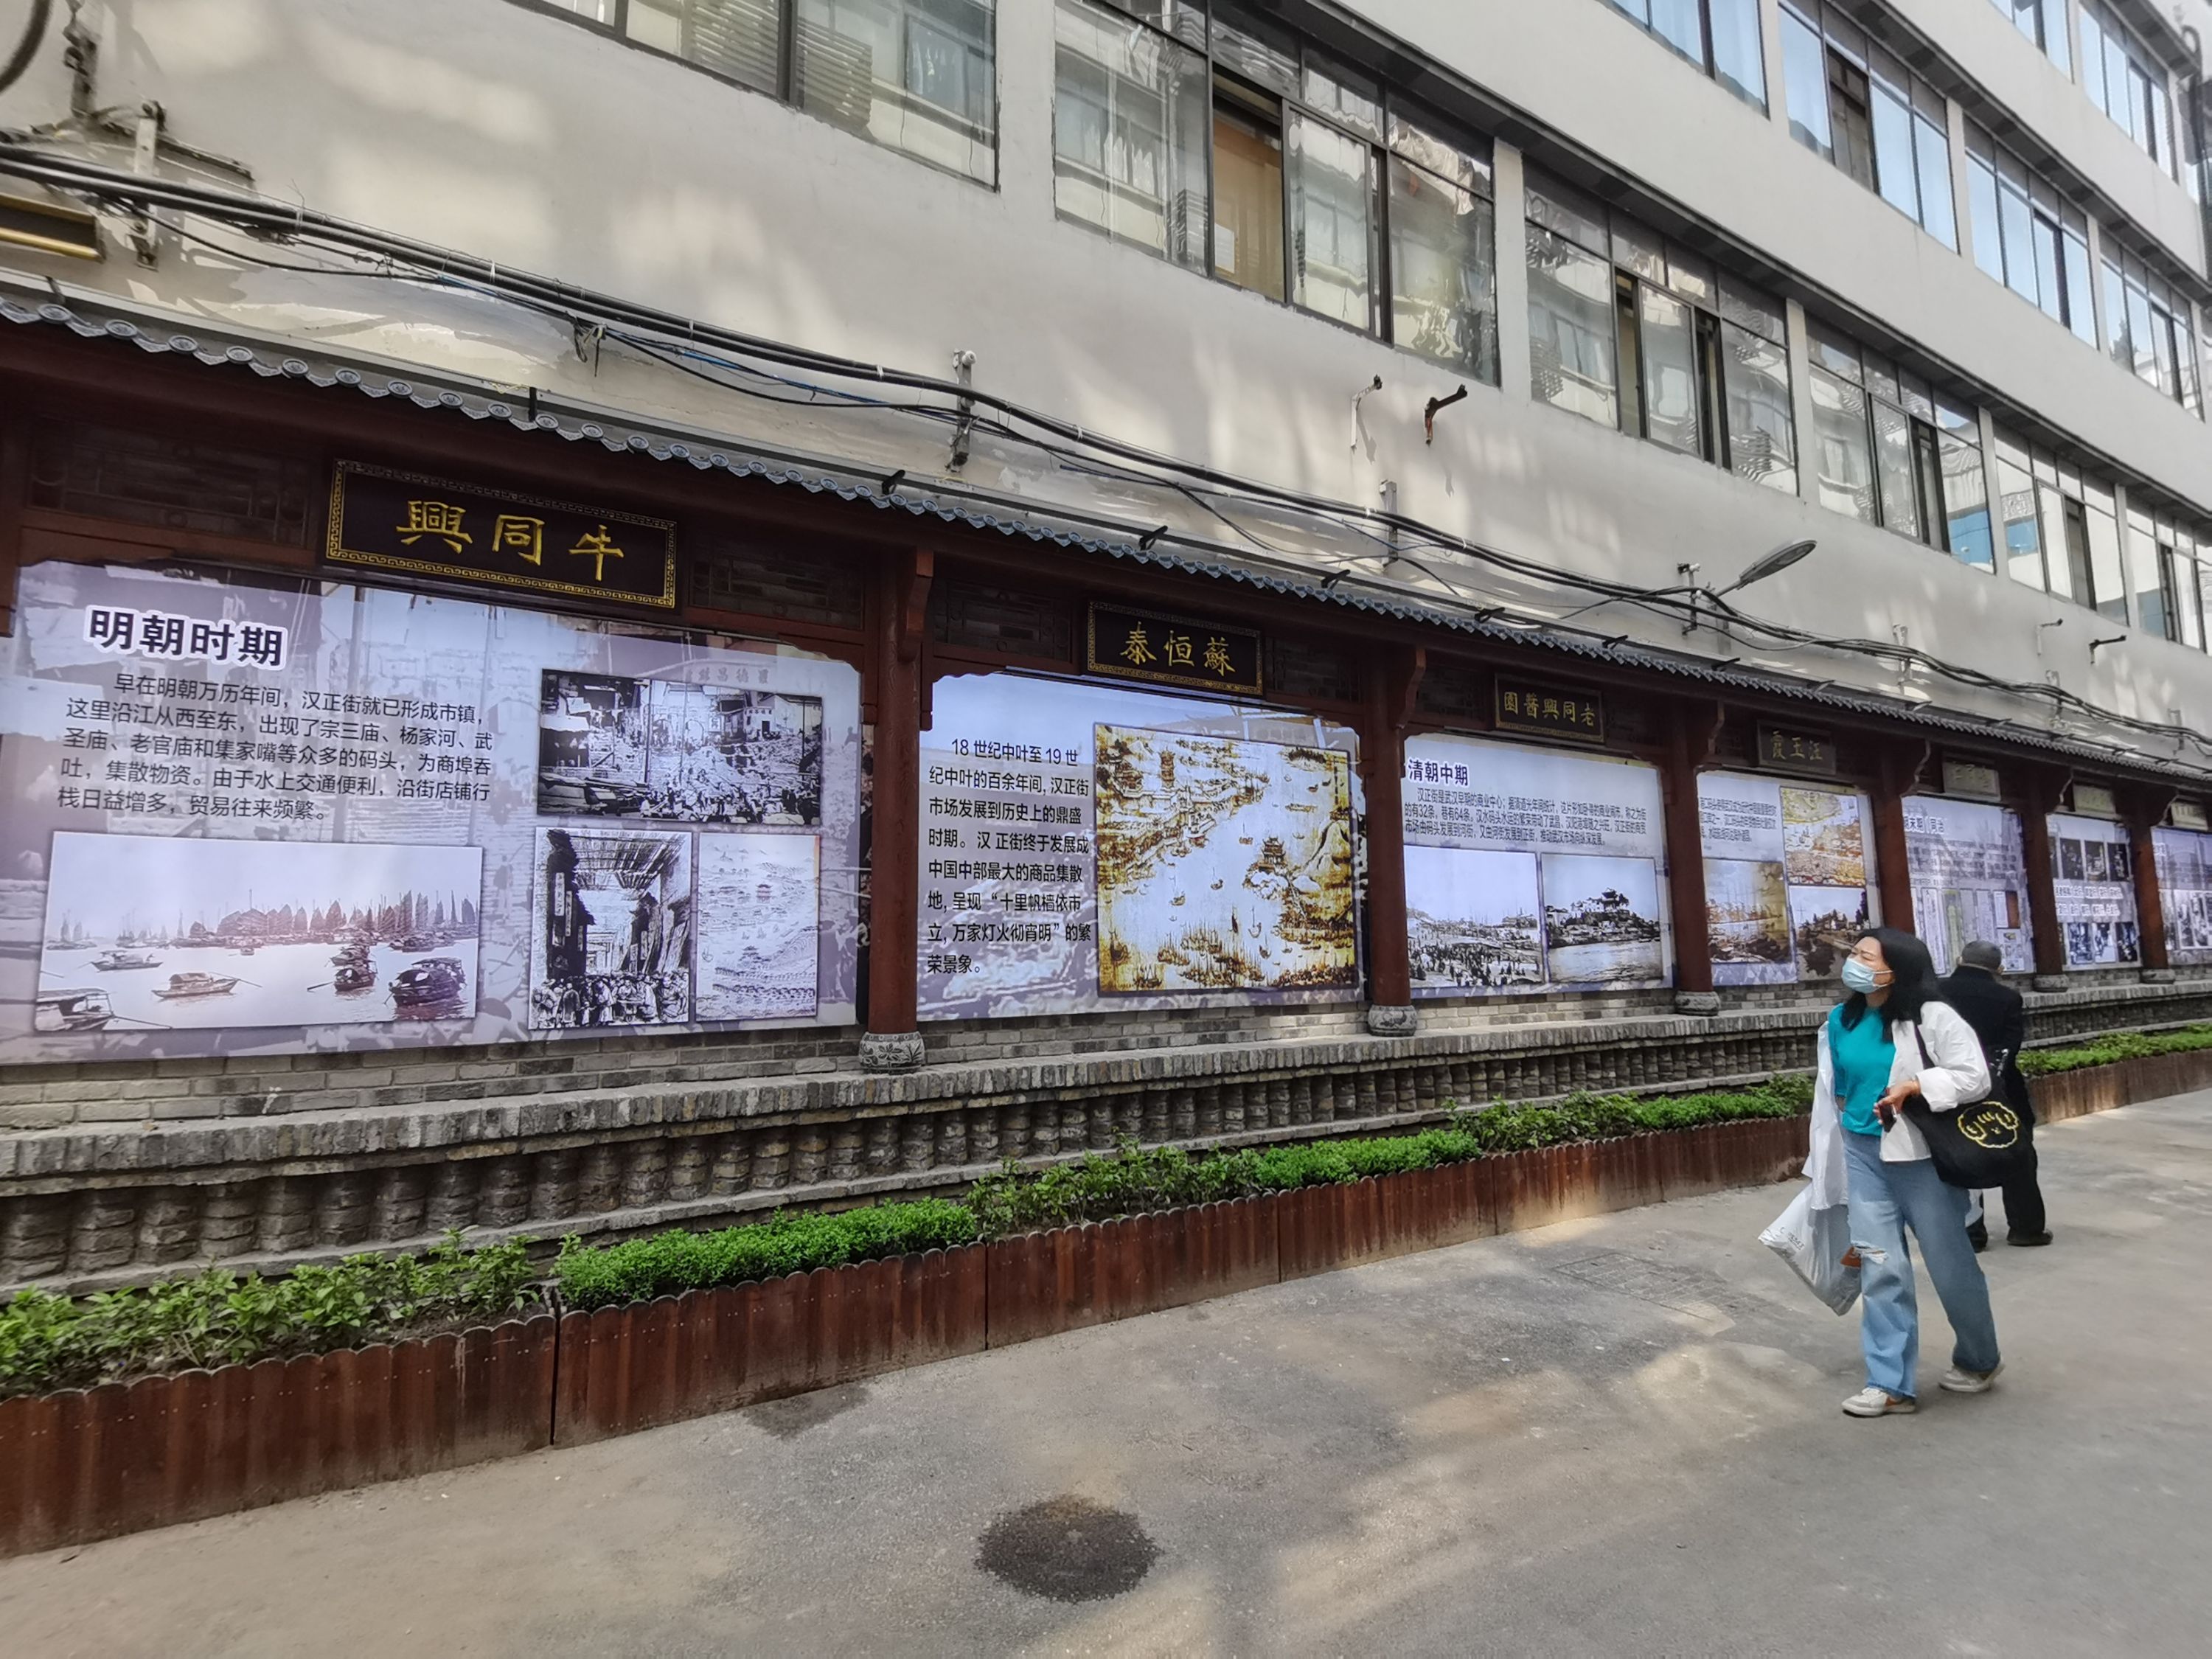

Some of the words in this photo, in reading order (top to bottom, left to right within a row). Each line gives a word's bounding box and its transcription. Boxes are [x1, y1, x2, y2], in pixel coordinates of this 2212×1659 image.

[89, 609, 283, 667] 明朝时期
[1408, 759, 1469, 786] 清朝中期
[929, 797, 1082, 824] 市场发展到历史上的鼎盛
[928, 860, 1082, 883] 中国中部最大的商品集散
[927, 954, 981, 974] 荣景象。
